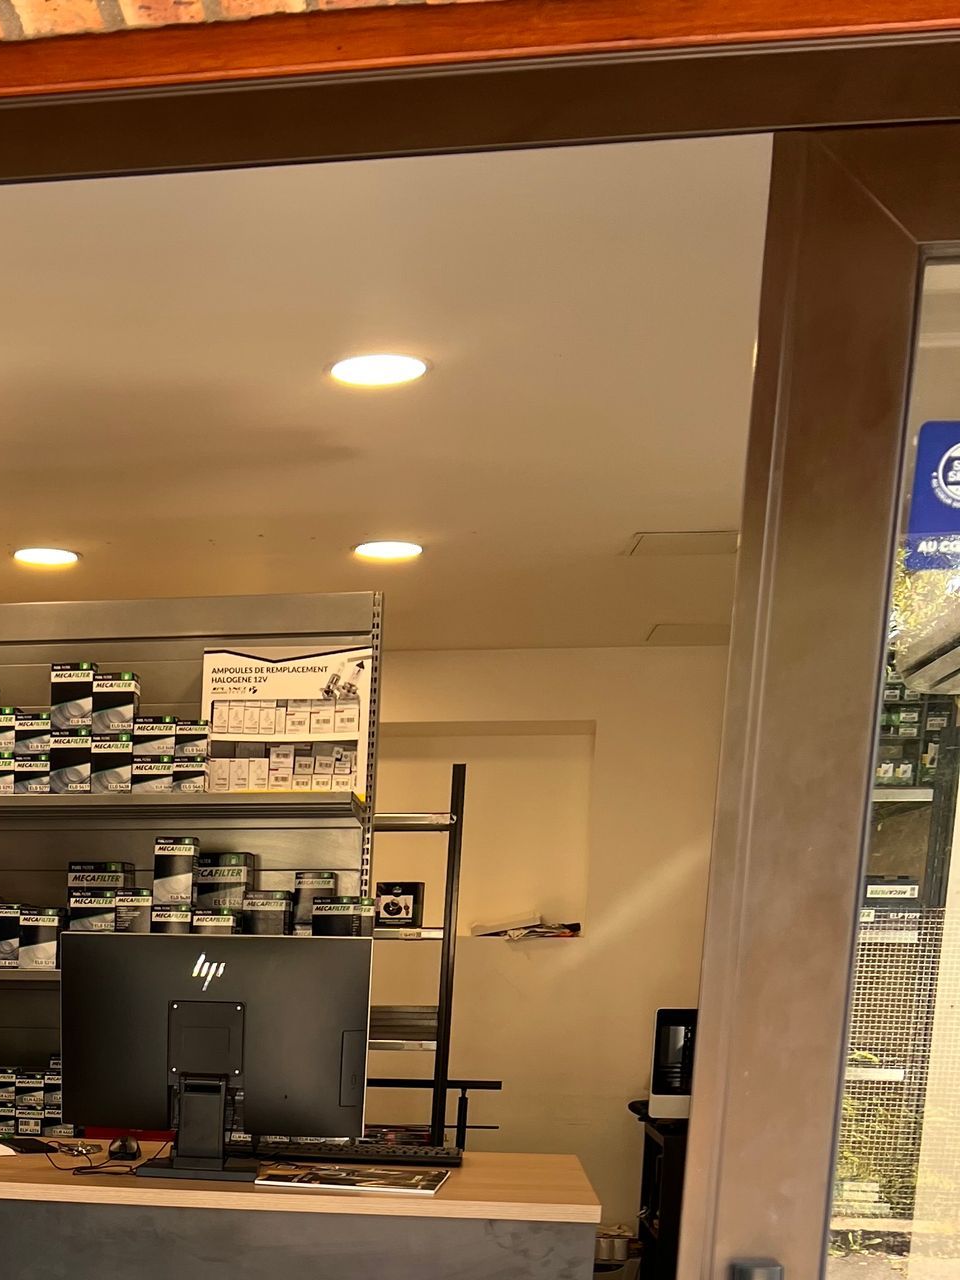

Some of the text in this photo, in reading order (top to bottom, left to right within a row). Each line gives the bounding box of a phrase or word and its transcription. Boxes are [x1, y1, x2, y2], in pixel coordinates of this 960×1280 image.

[254, 666, 264, 674] DE
[72, 874, 120, 882] MECAFILTER
[192, 953, 226, 991] hp
